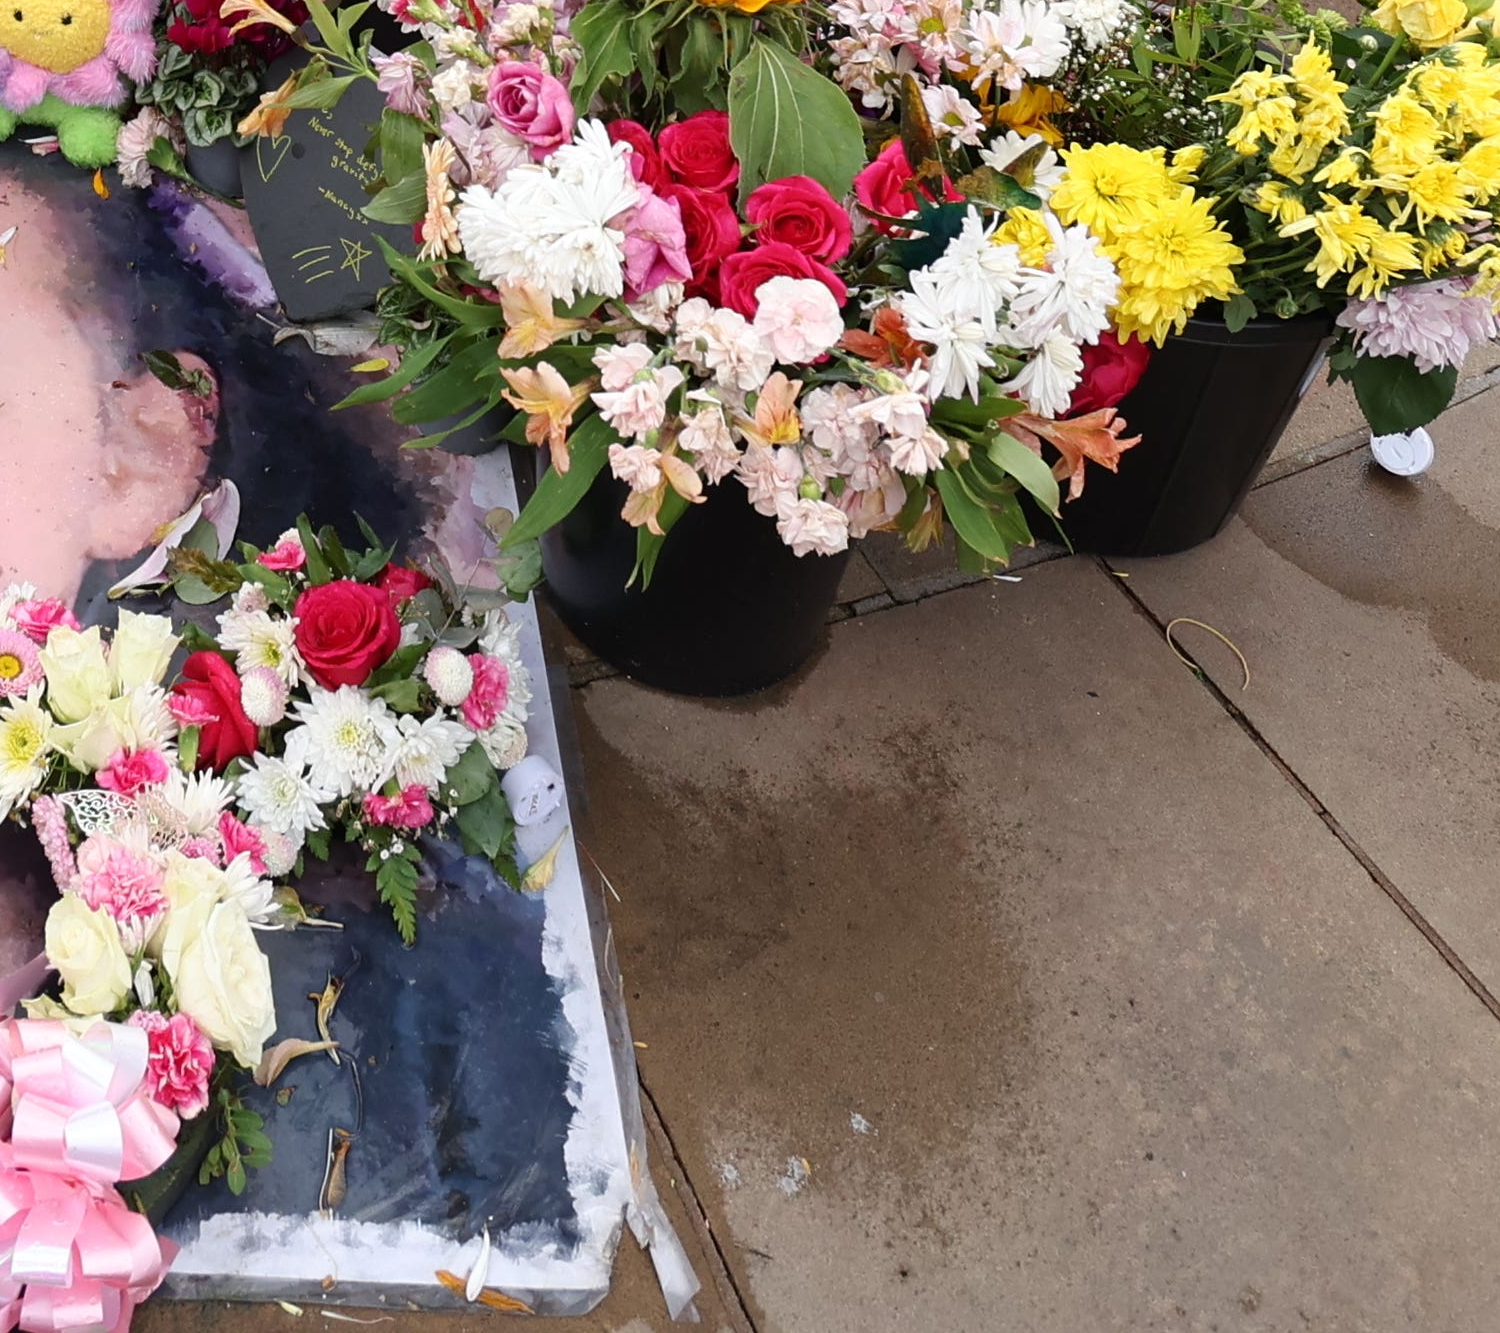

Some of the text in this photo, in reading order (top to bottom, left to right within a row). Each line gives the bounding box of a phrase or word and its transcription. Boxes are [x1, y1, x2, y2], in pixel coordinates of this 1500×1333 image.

[307, 116, 384, 183] Never stop defy
